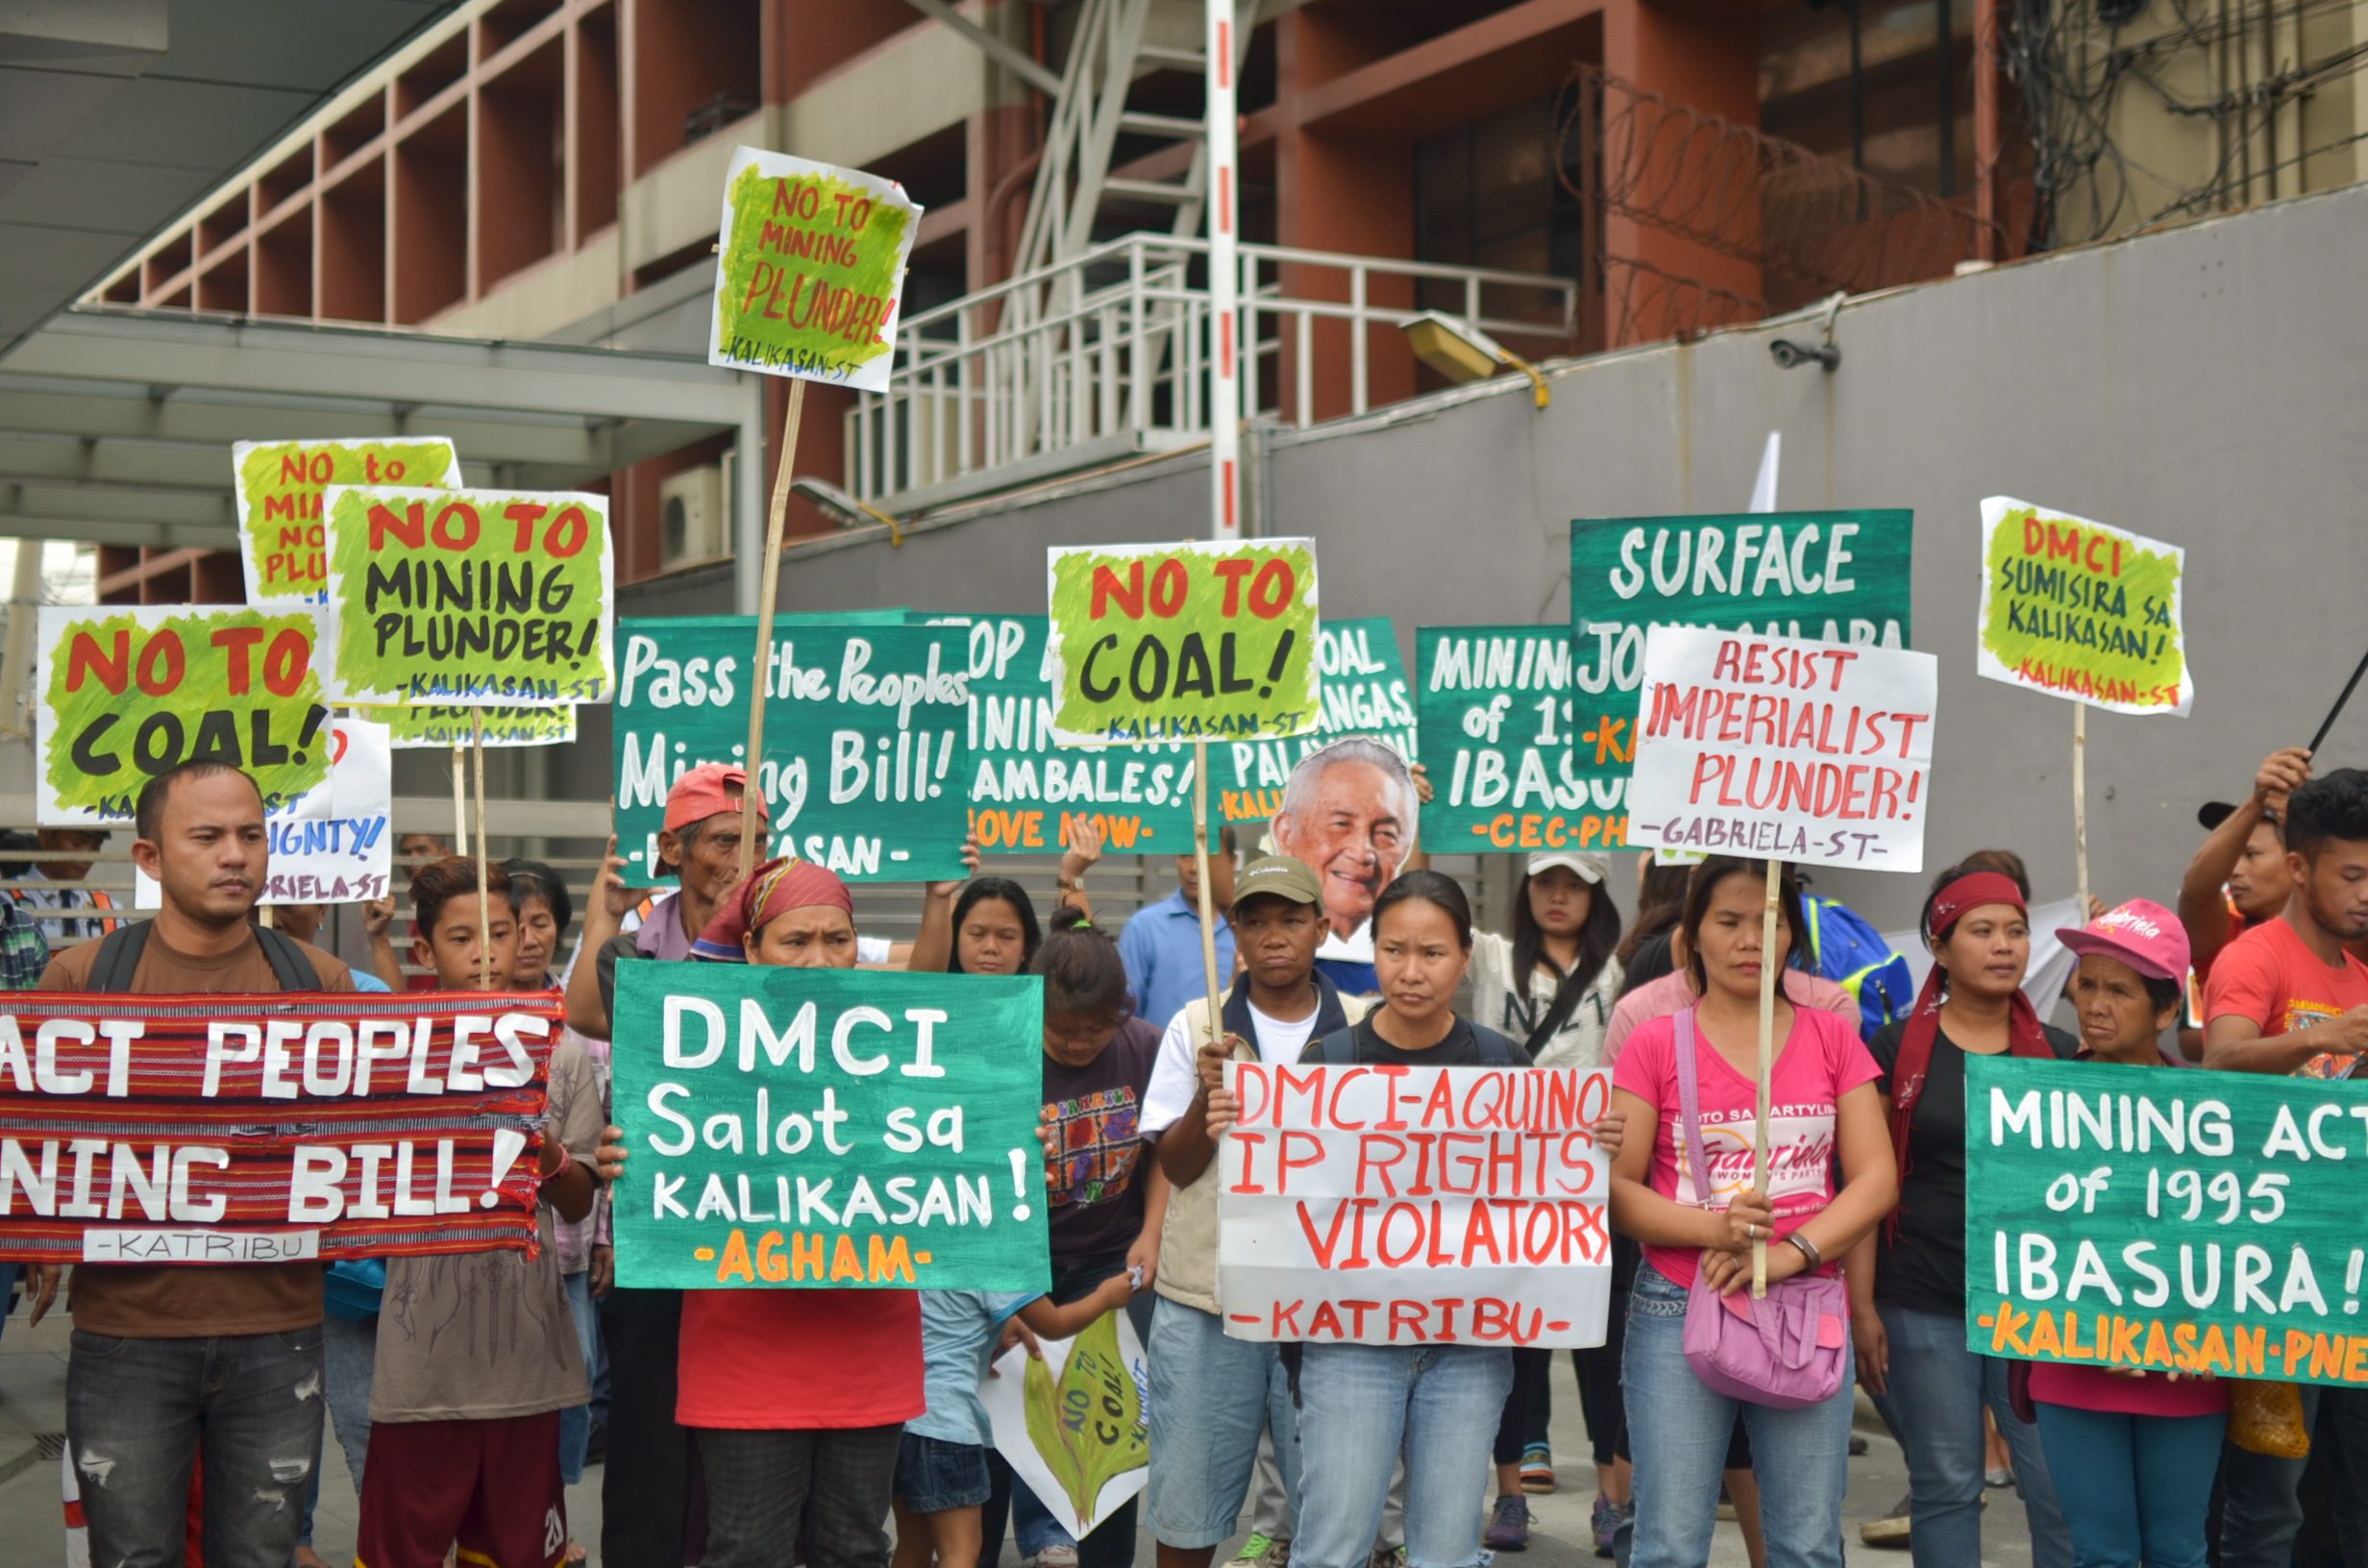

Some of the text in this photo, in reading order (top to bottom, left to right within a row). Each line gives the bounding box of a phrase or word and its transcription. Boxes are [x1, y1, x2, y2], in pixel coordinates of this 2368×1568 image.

[773, 178, 872, 232] NO TO
[758, 219, 858, 269] MINING
[743, 261, 897, 346] PLUNDER!
[719, 335, 862, 381] -KALIKASAN-ST
[280, 453, 406, 485] NO to
[367, 502, 589, 558] NO TO
[1609, 523, 1860, 600] SURFACE
[2024, 517, 2121, 578] DMCI
[365, 557, 574, 615] MINING
[1089, 557, 1295, 622] NO TO
[2000, 555, 2171, 629] SUMISIRA SA
[65, 626, 310, 698] NO TO
[374, 612, 598, 671] PLUNDER!
[1430, 636, 1571, 692] MININ
[2008, 600, 2167, 665] KALIKASAN!
[396, 673, 605, 699] -KALIKASAN-ST
[619, 635, 737, 708] Pass
[752, 641, 830, 700] the
[836, 638, 970, 730] Peoples
[1079, 628, 1296, 704] COAL!
[1713, 640, 1859, 692] RESIST
[2010, 657, 2181, 708] -KALIKASAN-ST
[71, 704, 329, 776] COAL!
[1095, 711, 1307, 742] -KALIKASAN-ST
[1463, 695, 1513, 745] of
[1646, 682, 1930, 759] IMPERIALIST
[829, 729, 955, 805] Bill!
[969, 759, 1196, 808] AMBALES!
[1447, 748, 1631, 812] IBASU
[1689, 752, 1922, 821] PLUNDER!
[968, 808, 1045, 847] OVE
[1640, 817, 1889, 862] -GABRIELA-ST-
[201, 1013, 550, 1098] PEOPLES
[663, 994, 949, 1078] DMCI
[647, 1082, 963, 1157] Salot sa
[1234, 1063, 1610, 1132] DMCI-AQUINO
[1730, 1108, 1754, 1121] SA
[1990, 1087, 2234, 1157] MINING
[287, 1128, 528, 1223] BILL!
[654, 1148, 1031, 1228] KALIKASAN!
[1229, 1131, 1595, 1198] IP RIGHTS
[2045, 1165, 2291, 1225] of 1995
[97, 1233, 303, 1259] -KATRIBU
[694, 1230, 932, 1284] -AGHAM-
[1295, 1197, 1611, 1270] VIOLATORS
[1994, 1230, 2365, 1316] IBASURA!
[1229, 1298, 1572, 1346] -KATRIBU-
[1062, 1388, 1092, 1434] NO
[1096, 1351, 1124, 1446] COAL!
